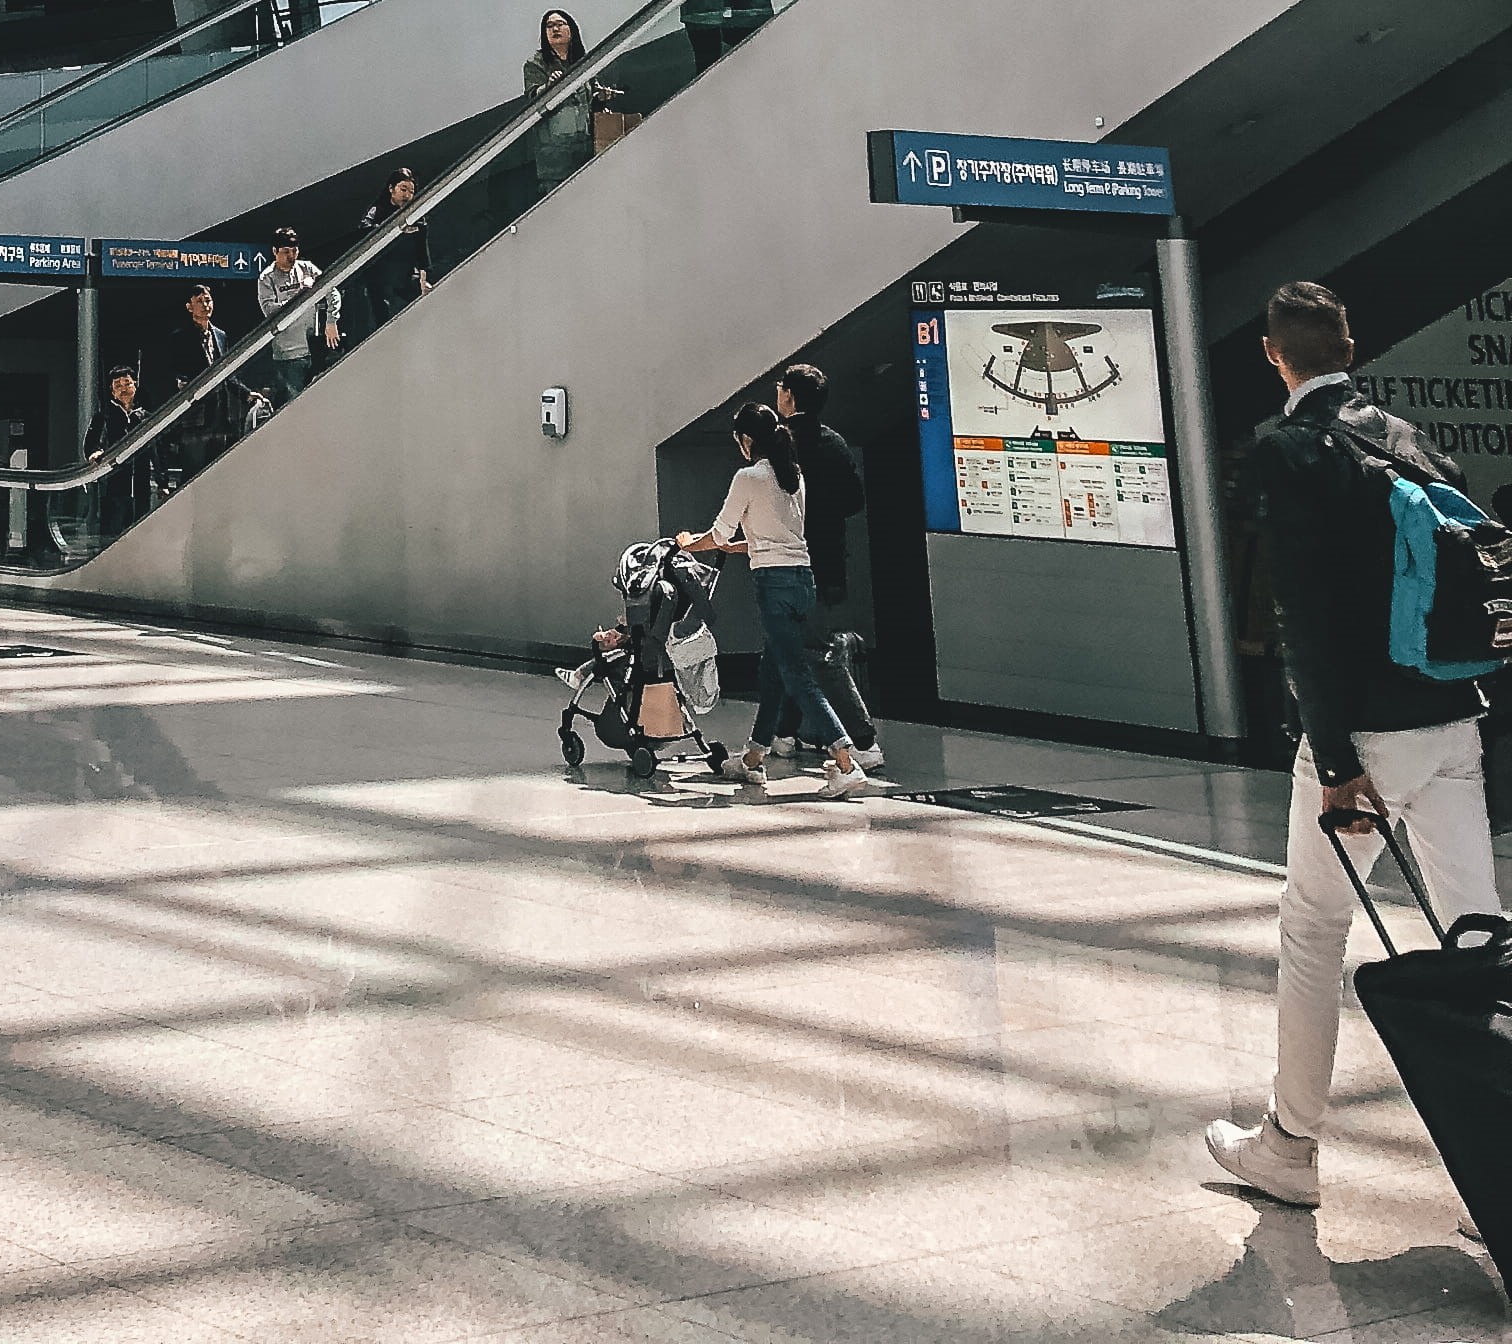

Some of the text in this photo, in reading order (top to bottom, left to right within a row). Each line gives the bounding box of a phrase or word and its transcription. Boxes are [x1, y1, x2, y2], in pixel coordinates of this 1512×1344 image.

[932, 155, 946, 180] P
[1063, 181, 1085, 197] Long
[1085, 182, 1104, 194] Term
[29, 256, 81, 271] Parking Area
[917, 317, 940, 345] B1
[1467, 334, 1512, 365] SN
